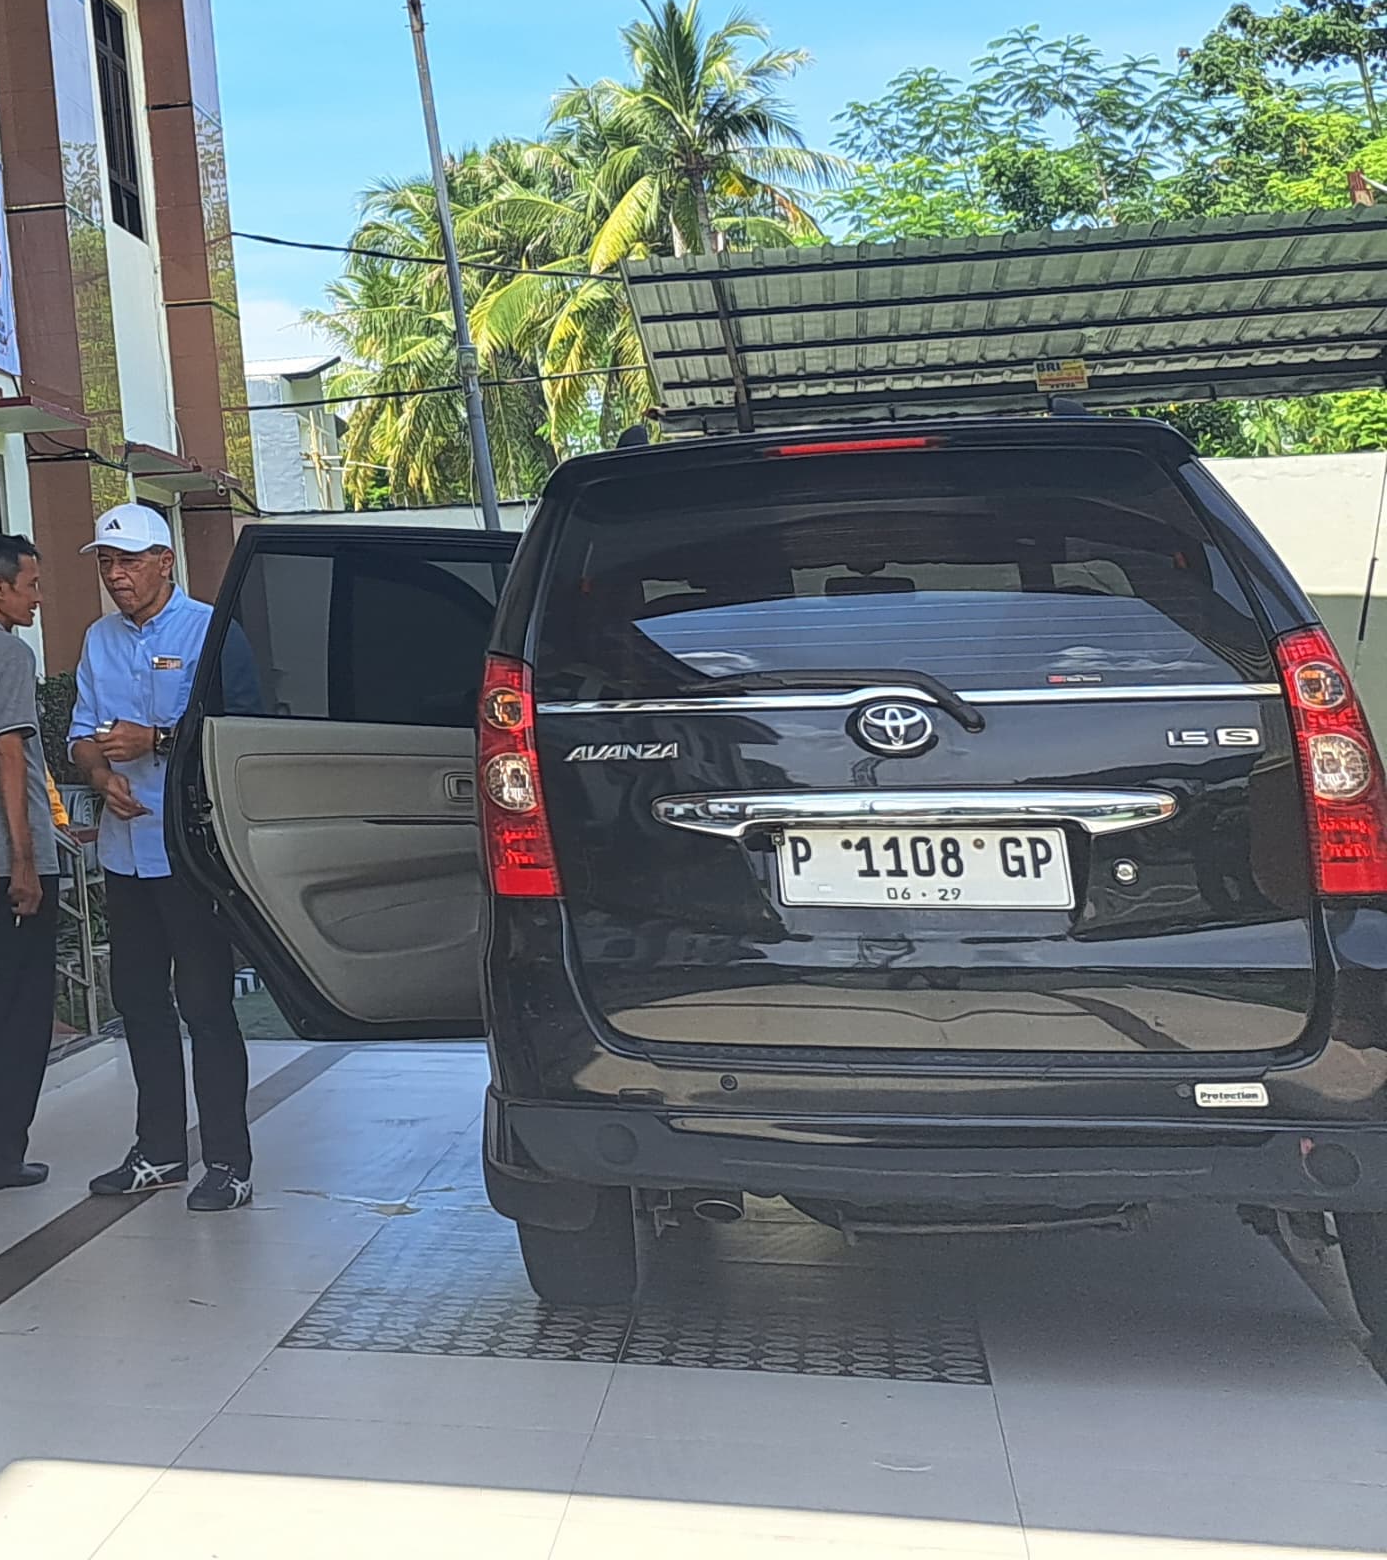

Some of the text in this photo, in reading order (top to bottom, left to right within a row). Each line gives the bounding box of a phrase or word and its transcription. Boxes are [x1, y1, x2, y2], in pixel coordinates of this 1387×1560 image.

[563, 742, 678, 761] AVANZA
[788, 835, 1053, 878] P 1108 GP
[886, 887, 962, 901] 06 29
[1200, 1091, 1259, 1100] Protection
